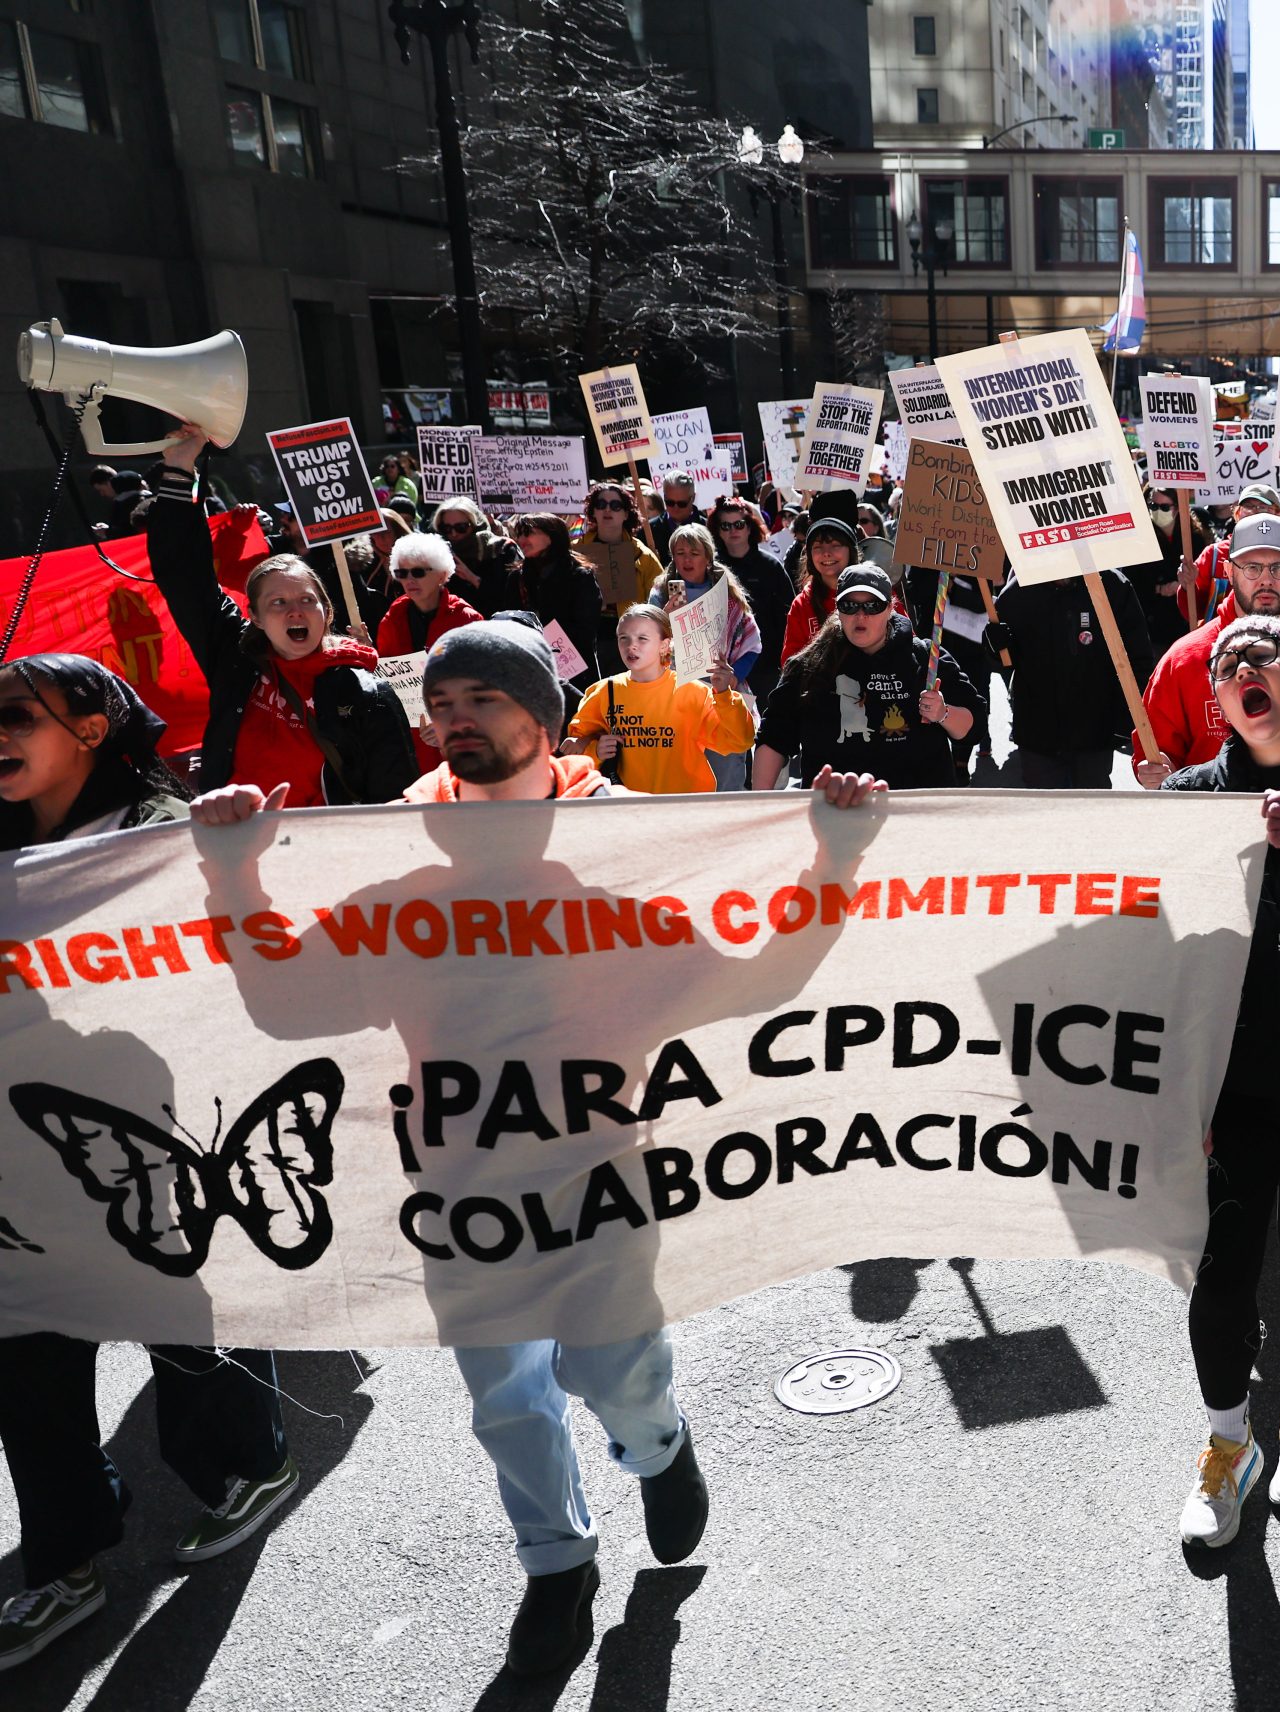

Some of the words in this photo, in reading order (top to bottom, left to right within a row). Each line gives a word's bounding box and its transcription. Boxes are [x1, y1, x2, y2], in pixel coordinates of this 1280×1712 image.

[1102, 133, 1116, 147] P
[590, 377, 632, 393] INTERNATIONAL
[963, 357, 1080, 399] INTERNATIONAL
[592, 388, 621, 402] WOMEN'S
[622, 386, 635, 396] DAY
[822, 395, 874, 407] INTERNATIONAL
[902, 393, 951, 413] SOLIDARIDA
[971, 386, 1053, 423] WOMEN'S
[1053, 379, 1087, 405] DAY
[1146, 391, 1197, 414] DEFEND
[595, 399, 617, 413] STAND
[617, 396, 638, 408] WITH
[820, 405, 848, 420] STOP
[851, 409, 873, 426] THE
[907, 412, 934, 424] CON
[1149, 415, 1198, 424] WOMEN'S
[276, 425, 344, 443] RefuseFascism.org
[600, 416, 643, 435] IMMIGRANT
[676, 419, 704, 437] CAN
[816, 419, 870, 436] DEPORTATIONS
[981, 416, 1045, 450] STAND
[1044, 403, 1098, 437] WITH
[1244, 424, 1275, 440] STOP
[532, 437, 571, 449] Message
[609, 429, 639, 444] WOMEN
[1163, 441, 1200, 449] LGBTQ
[282, 441, 351, 469] TRUMP
[421, 442, 469, 466] NEED
[497, 447, 523, 458] Jeffrey
[524, 447, 554, 458] Epstein
[665, 440, 689, 455] DO
[811, 441, 828, 451] KEEP
[829, 442, 864, 458] FAMILIES
[552, 463, 569, 471] 2011
[659, 461, 678, 470] CAN
[809, 451, 861, 472] TOGETHER
[911, 444, 977, 476] Bombin
[1156, 450, 1199, 471] RIGHTS
[296, 460, 350, 487] MUST
[1002, 460, 1115, 505] IMMIGRANT
[1154, 472, 1177, 480] FRSO
[317, 482, 346, 501] GO
[424, 474, 446, 491] W/
[452, 475, 475, 492] IRA
[931, 473, 984, 505] KID'S
[1217, 485, 1235, 496] THE
[313, 496, 363, 523] NOW!
[482, 505, 499, 513] with
[501, 505, 515, 513] him
[513, 496, 531, 505] spent
[534, 496, 552, 504] hours
[560, 497, 569, 505] my
[1028, 491, 1108, 528] WOMEN
[907, 496, 943, 519] Won't
[952, 506, 995, 526] Distra
[310, 515, 375, 535] RefuseFascism.org
[903, 520, 923, 533] us
[931, 520, 967, 541] from
[973, 527, 997, 545] the
[1075, 523, 1099, 532] Freedom
[1076, 528, 1100, 538] Socialist
[1100, 522, 1132, 533] Organization
[1022, 528, 1071, 548] FRSO
[920, 536, 982, 570] FILES
[674, 601, 707, 635] THE
[394, 660, 414, 675] JUST
[682, 652, 707, 676] IS
[408, 675, 424, 687] HAV
[867, 680, 903, 692] camp
[619, 715, 643, 725] NOT
[611, 727, 657, 737] ANTING
[659, 727, 675, 737] TO,
[637, 738, 660, 748] NOT
[664, 738, 674, 748] BE
[313, 895, 694, 959] WORKING
[711, 873, 1160, 945] COMMITTEE
[389, 1038, 722, 1173] ¡PARA
[748, 1001, 1165, 1095] CPD-ICE
[399, 1102, 1139, 1264] COLABORACIÓN!
